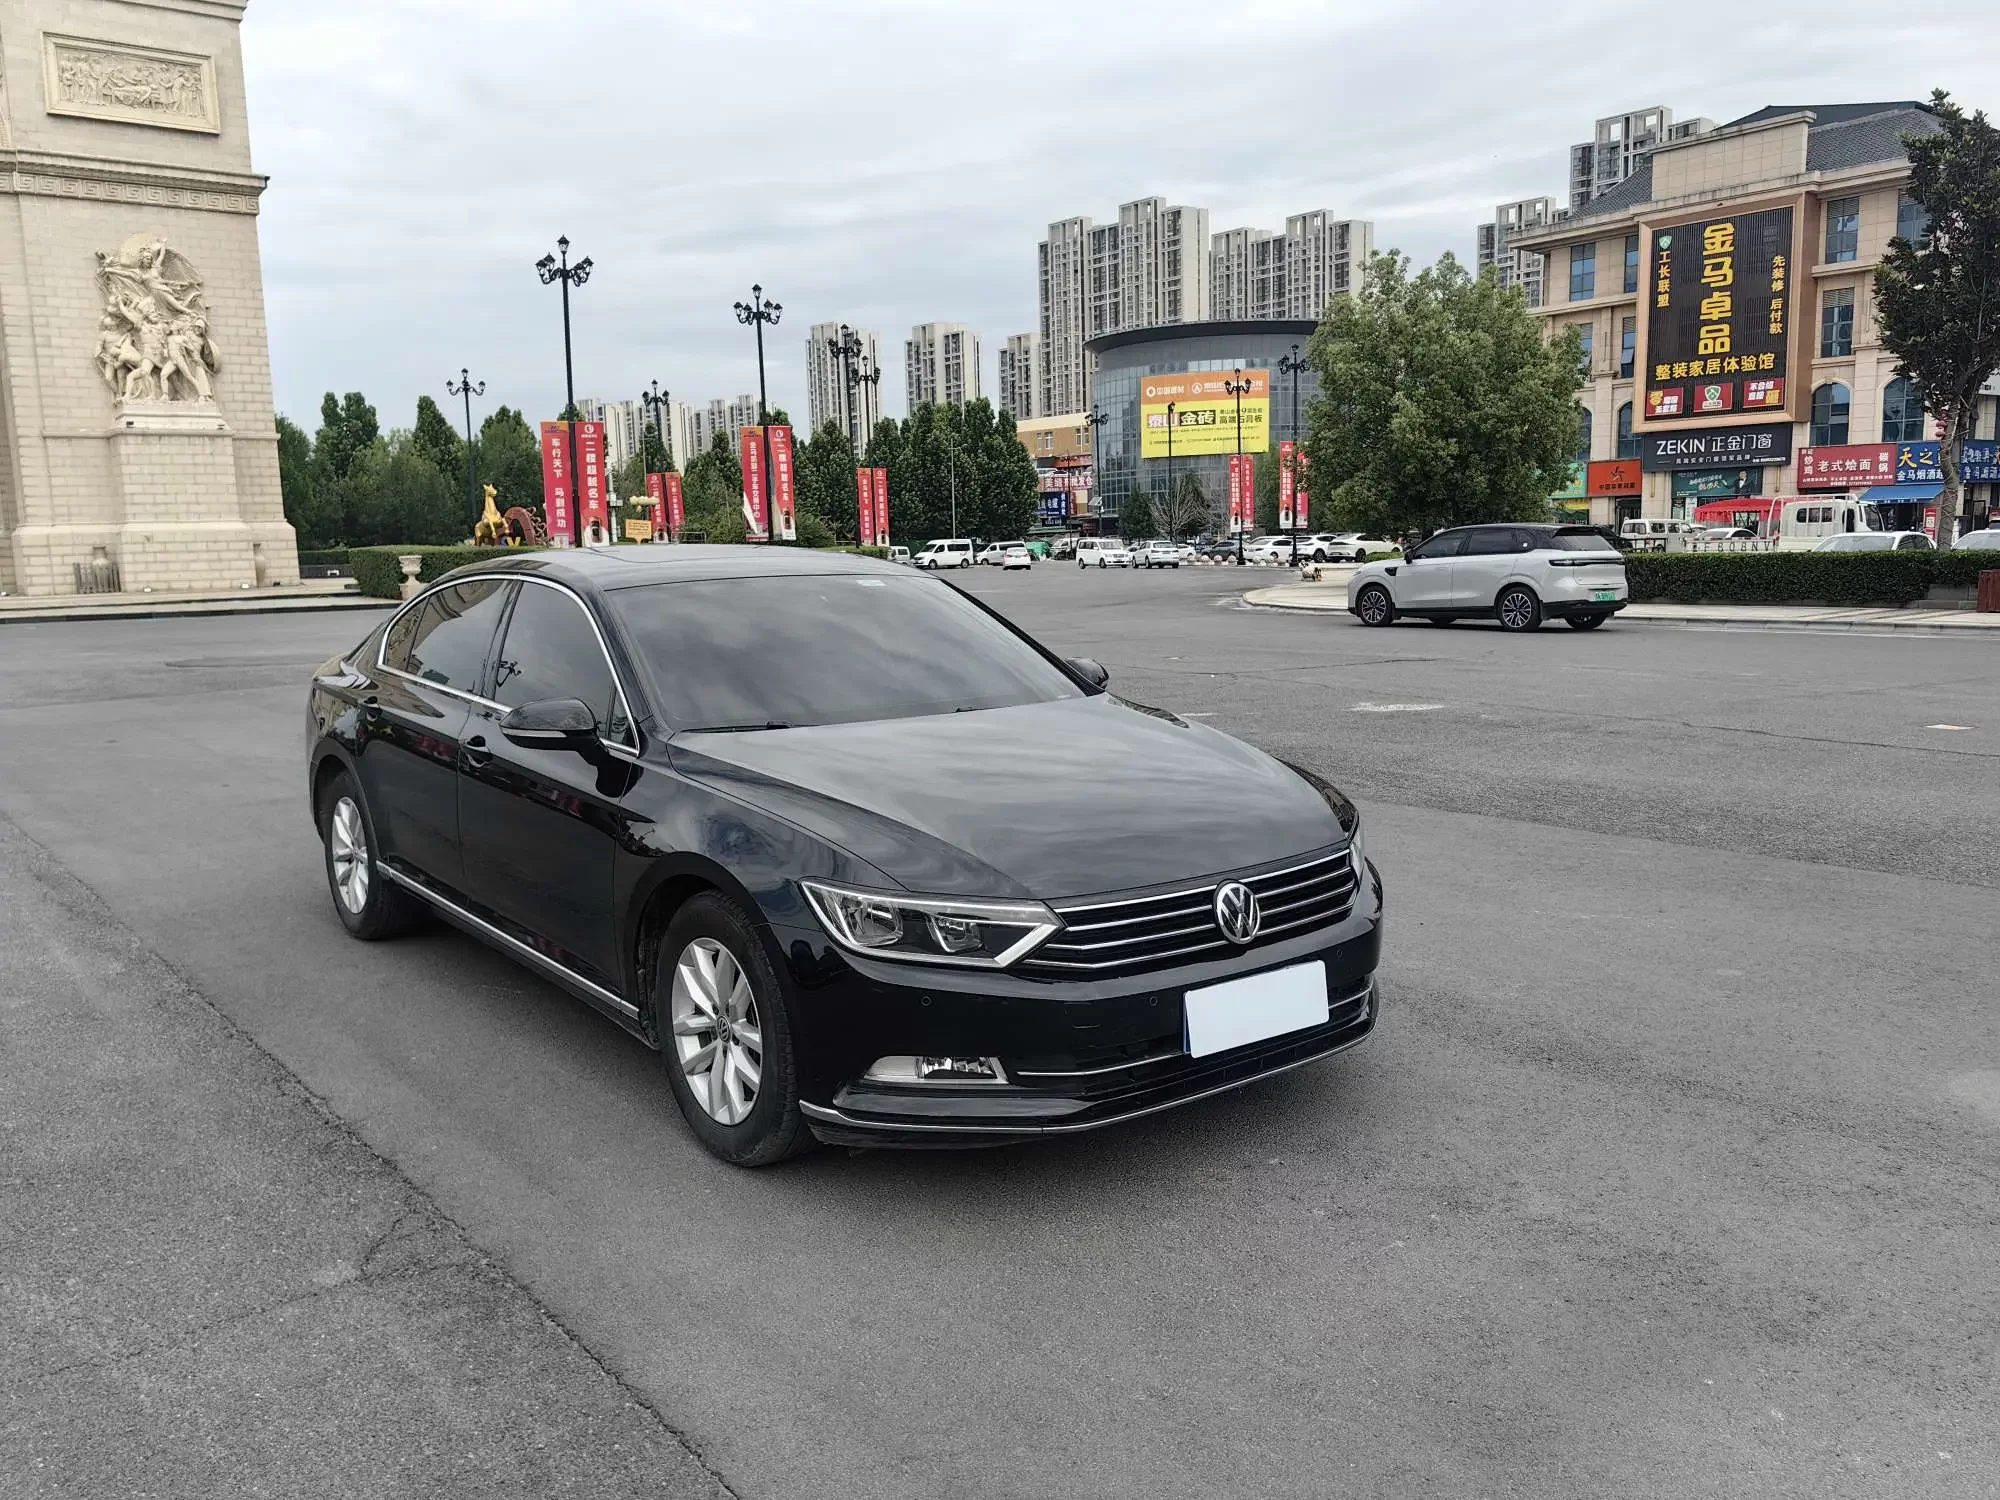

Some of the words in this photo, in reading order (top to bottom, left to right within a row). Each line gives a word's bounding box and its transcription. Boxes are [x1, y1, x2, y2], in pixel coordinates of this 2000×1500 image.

[1656, 251, 1671, 308] 工长联盟
[1698, 222, 1735, 355] 金马卓品
[1771, 255, 1786, 292] 先装修
[1769, 298, 1784, 334] 后付款
[1655, 353, 1775, 381] 整装家居体验馆
[1656, 437, 1706, 455] ZEKIN
[1711, 433, 1772, 452] 正金门窗
[1817, 459, 1872, 472] 老式烩面
